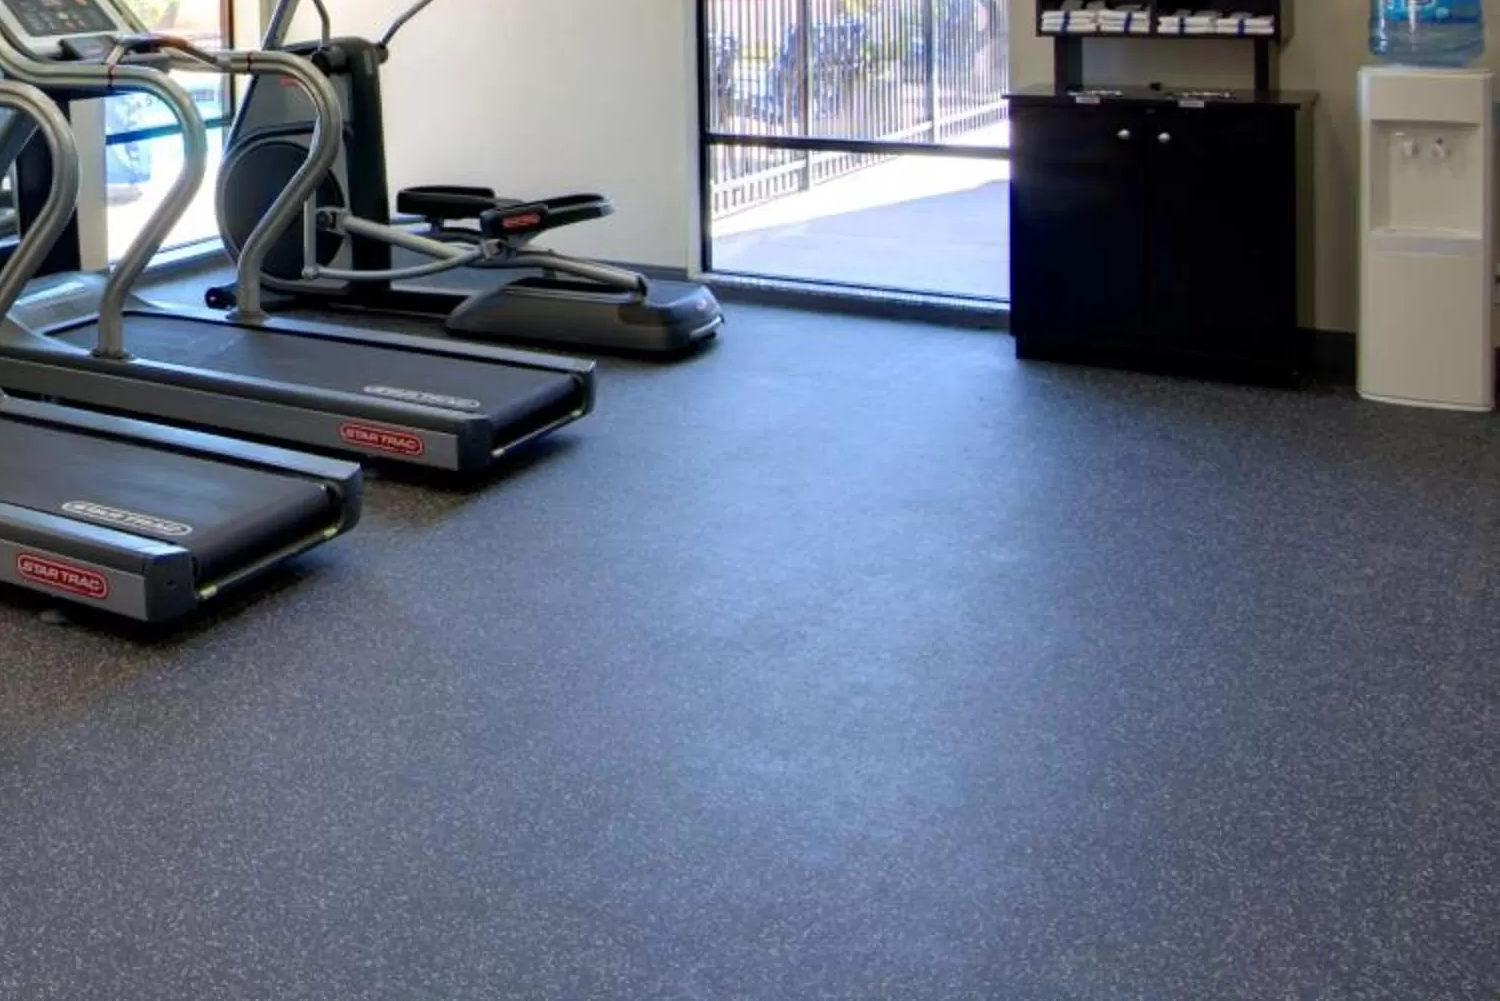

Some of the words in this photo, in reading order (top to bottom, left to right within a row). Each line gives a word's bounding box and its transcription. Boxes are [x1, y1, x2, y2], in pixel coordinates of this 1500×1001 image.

[345, 429, 379, 443] STAR
[380, 434, 417, 451] TRAC
[22, 561, 59, 580] STAR
[60, 570, 102, 592] TRAC
